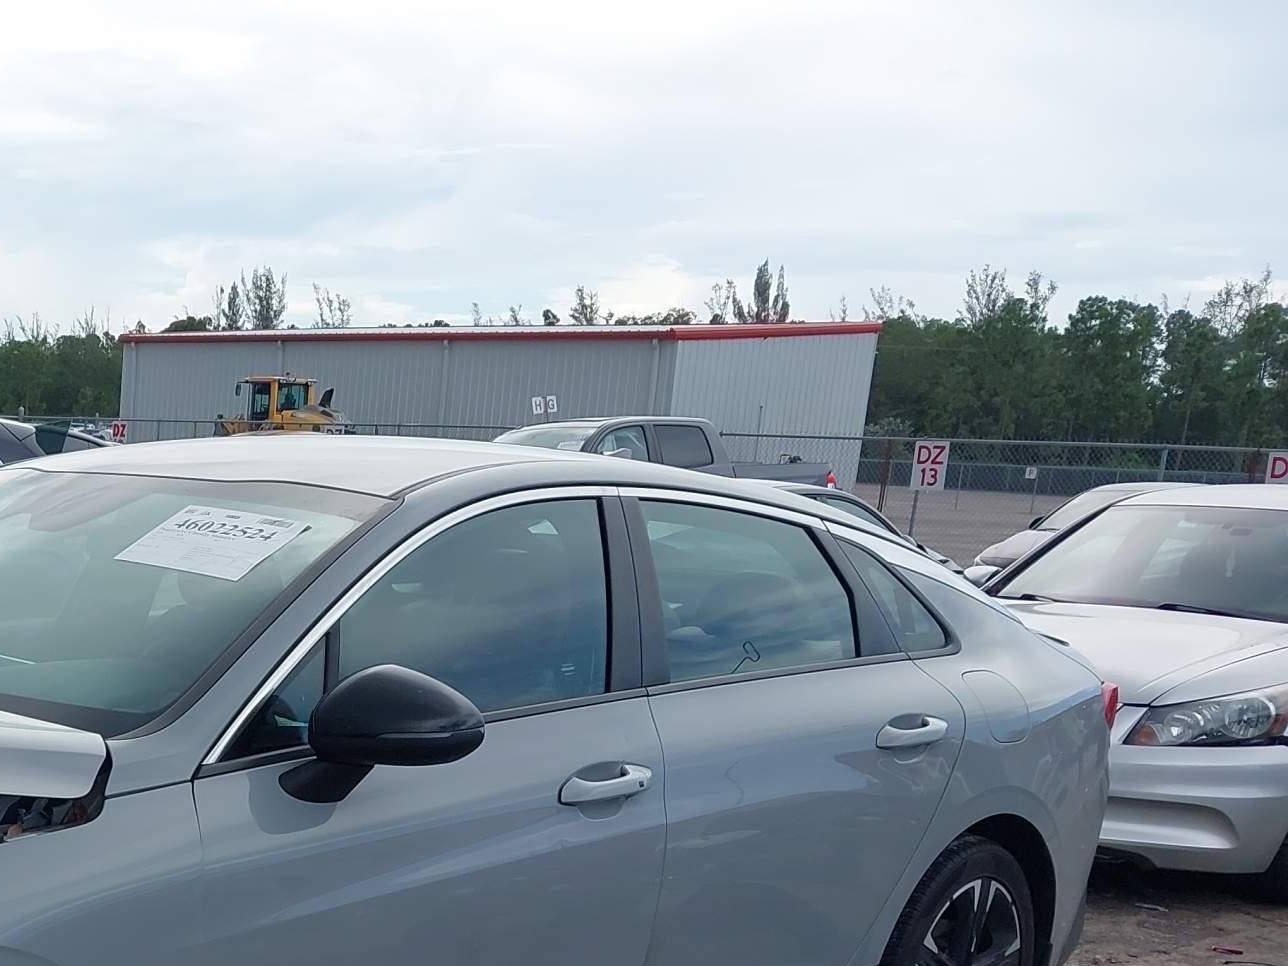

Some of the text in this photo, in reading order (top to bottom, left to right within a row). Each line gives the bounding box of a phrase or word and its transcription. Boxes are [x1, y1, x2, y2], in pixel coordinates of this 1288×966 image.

[112, 423, 127, 438] DZ
[916, 445, 946, 465] DZ
[920, 467, 938, 487] 13
[175, 518, 279, 542] 46022524
